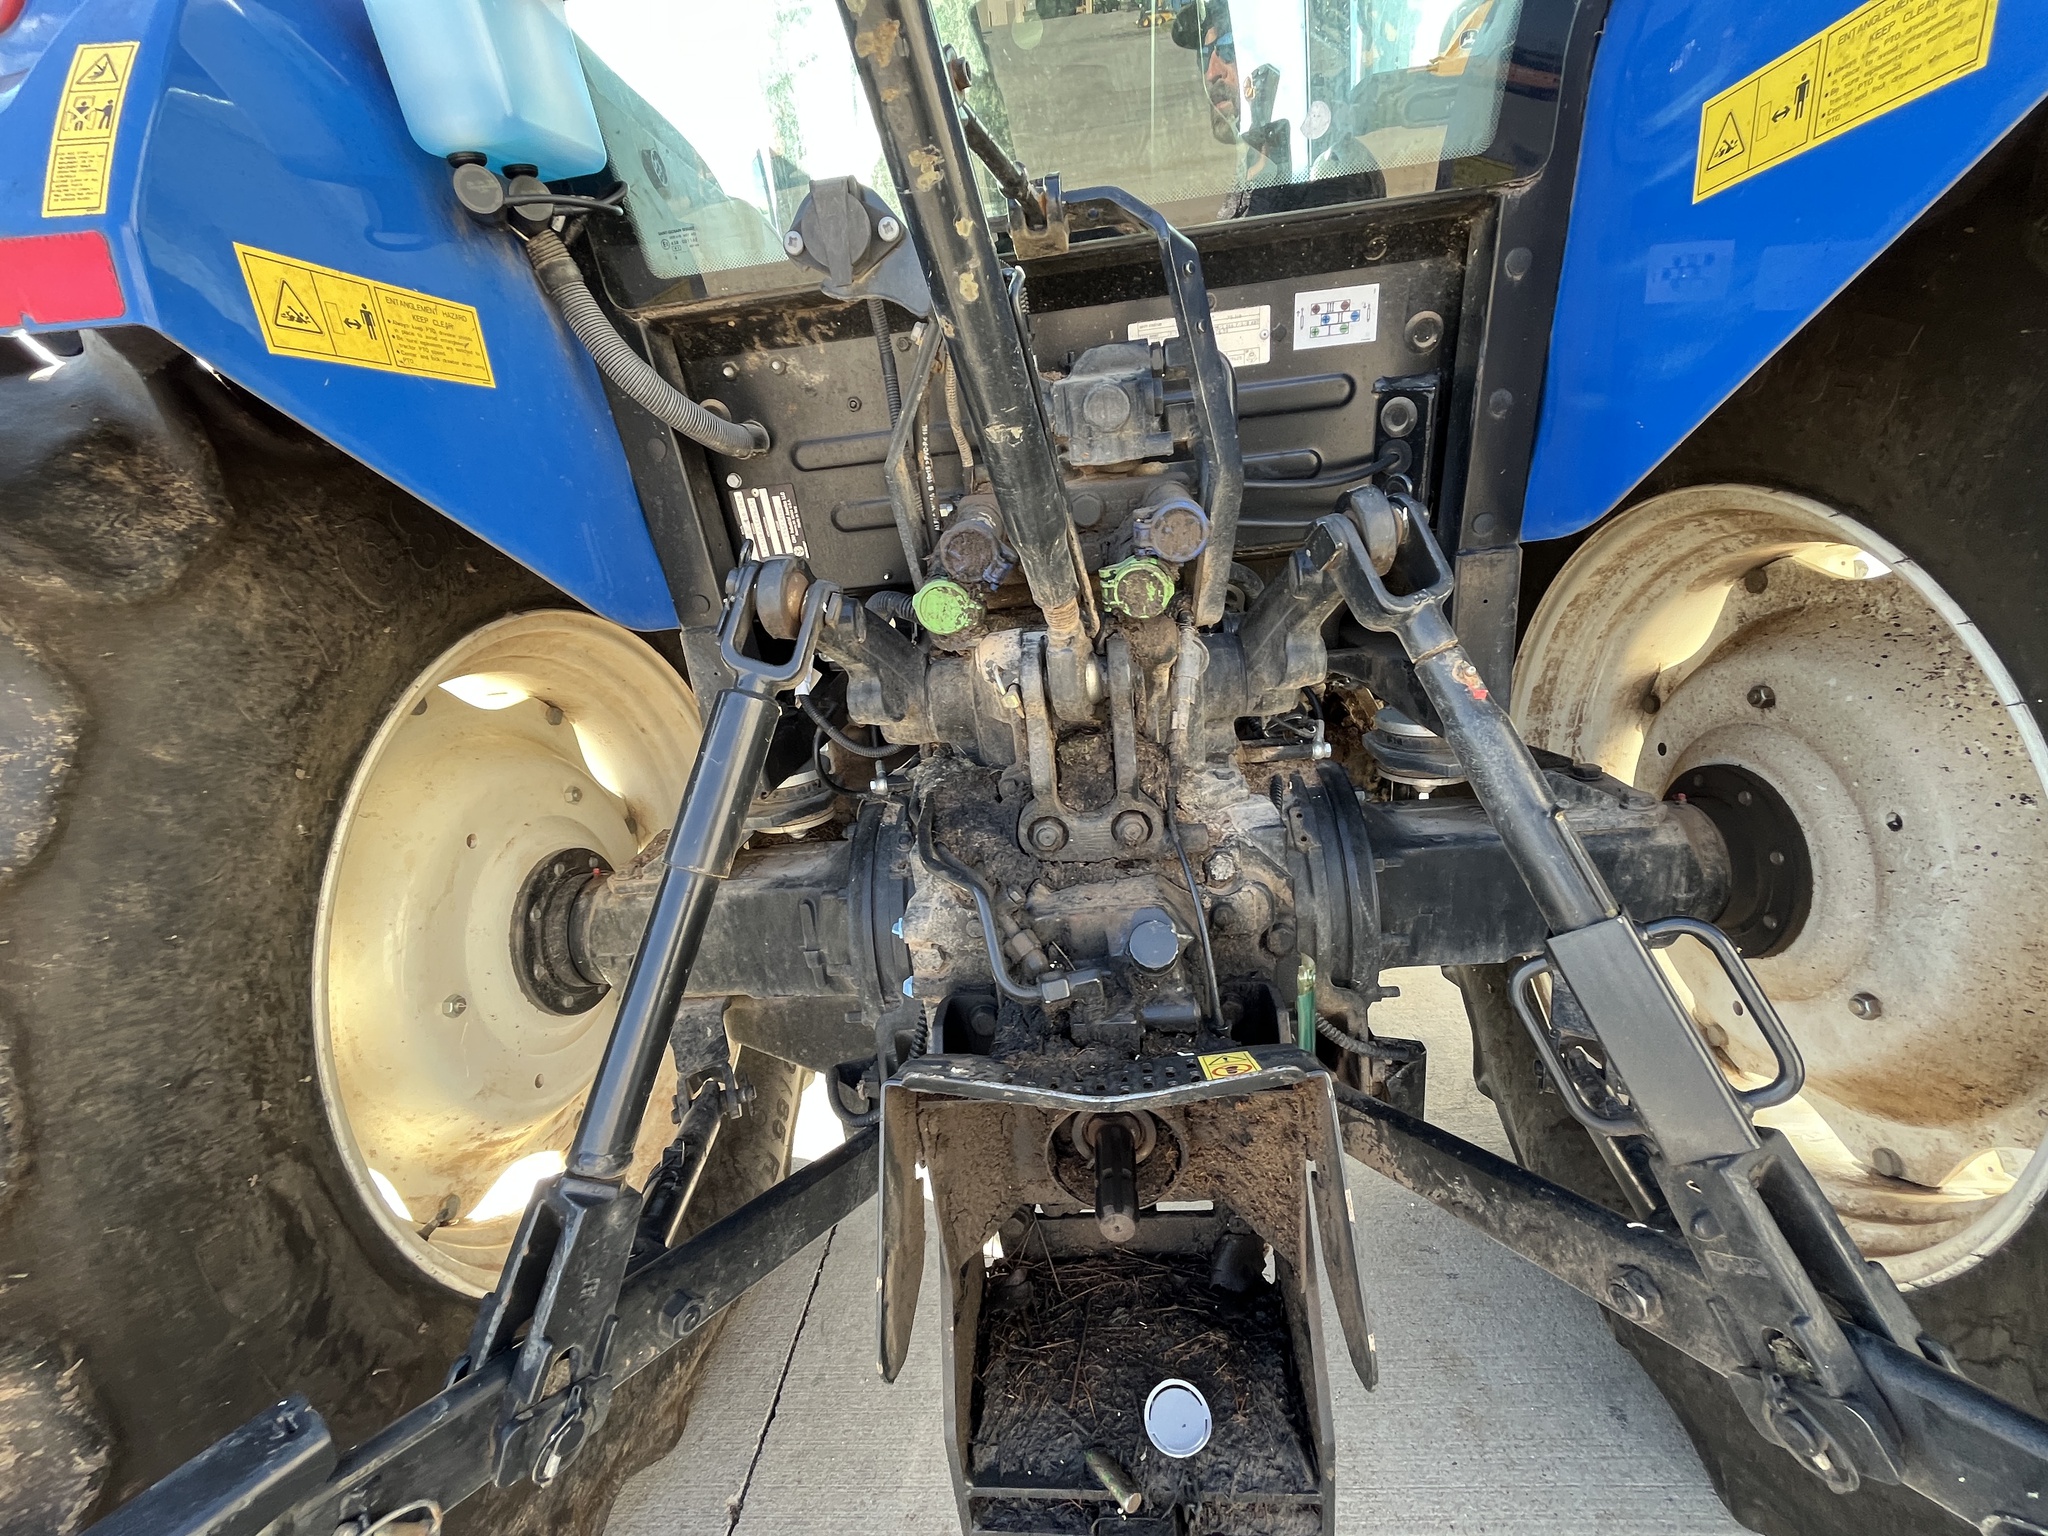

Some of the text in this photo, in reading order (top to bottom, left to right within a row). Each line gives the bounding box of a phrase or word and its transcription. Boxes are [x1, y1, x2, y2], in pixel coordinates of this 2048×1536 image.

[1838, 0, 1914, 45] ENTANGLEME
[1869, 20, 1896, 43] KEEP
[1884, 32, 1901, 47] PTO
[1857, 77, 1874, 91] PTO
[385, 296, 467, 322] ENTANGLEMENT HAZARD
[412, 315, 428, 323] KEEP
